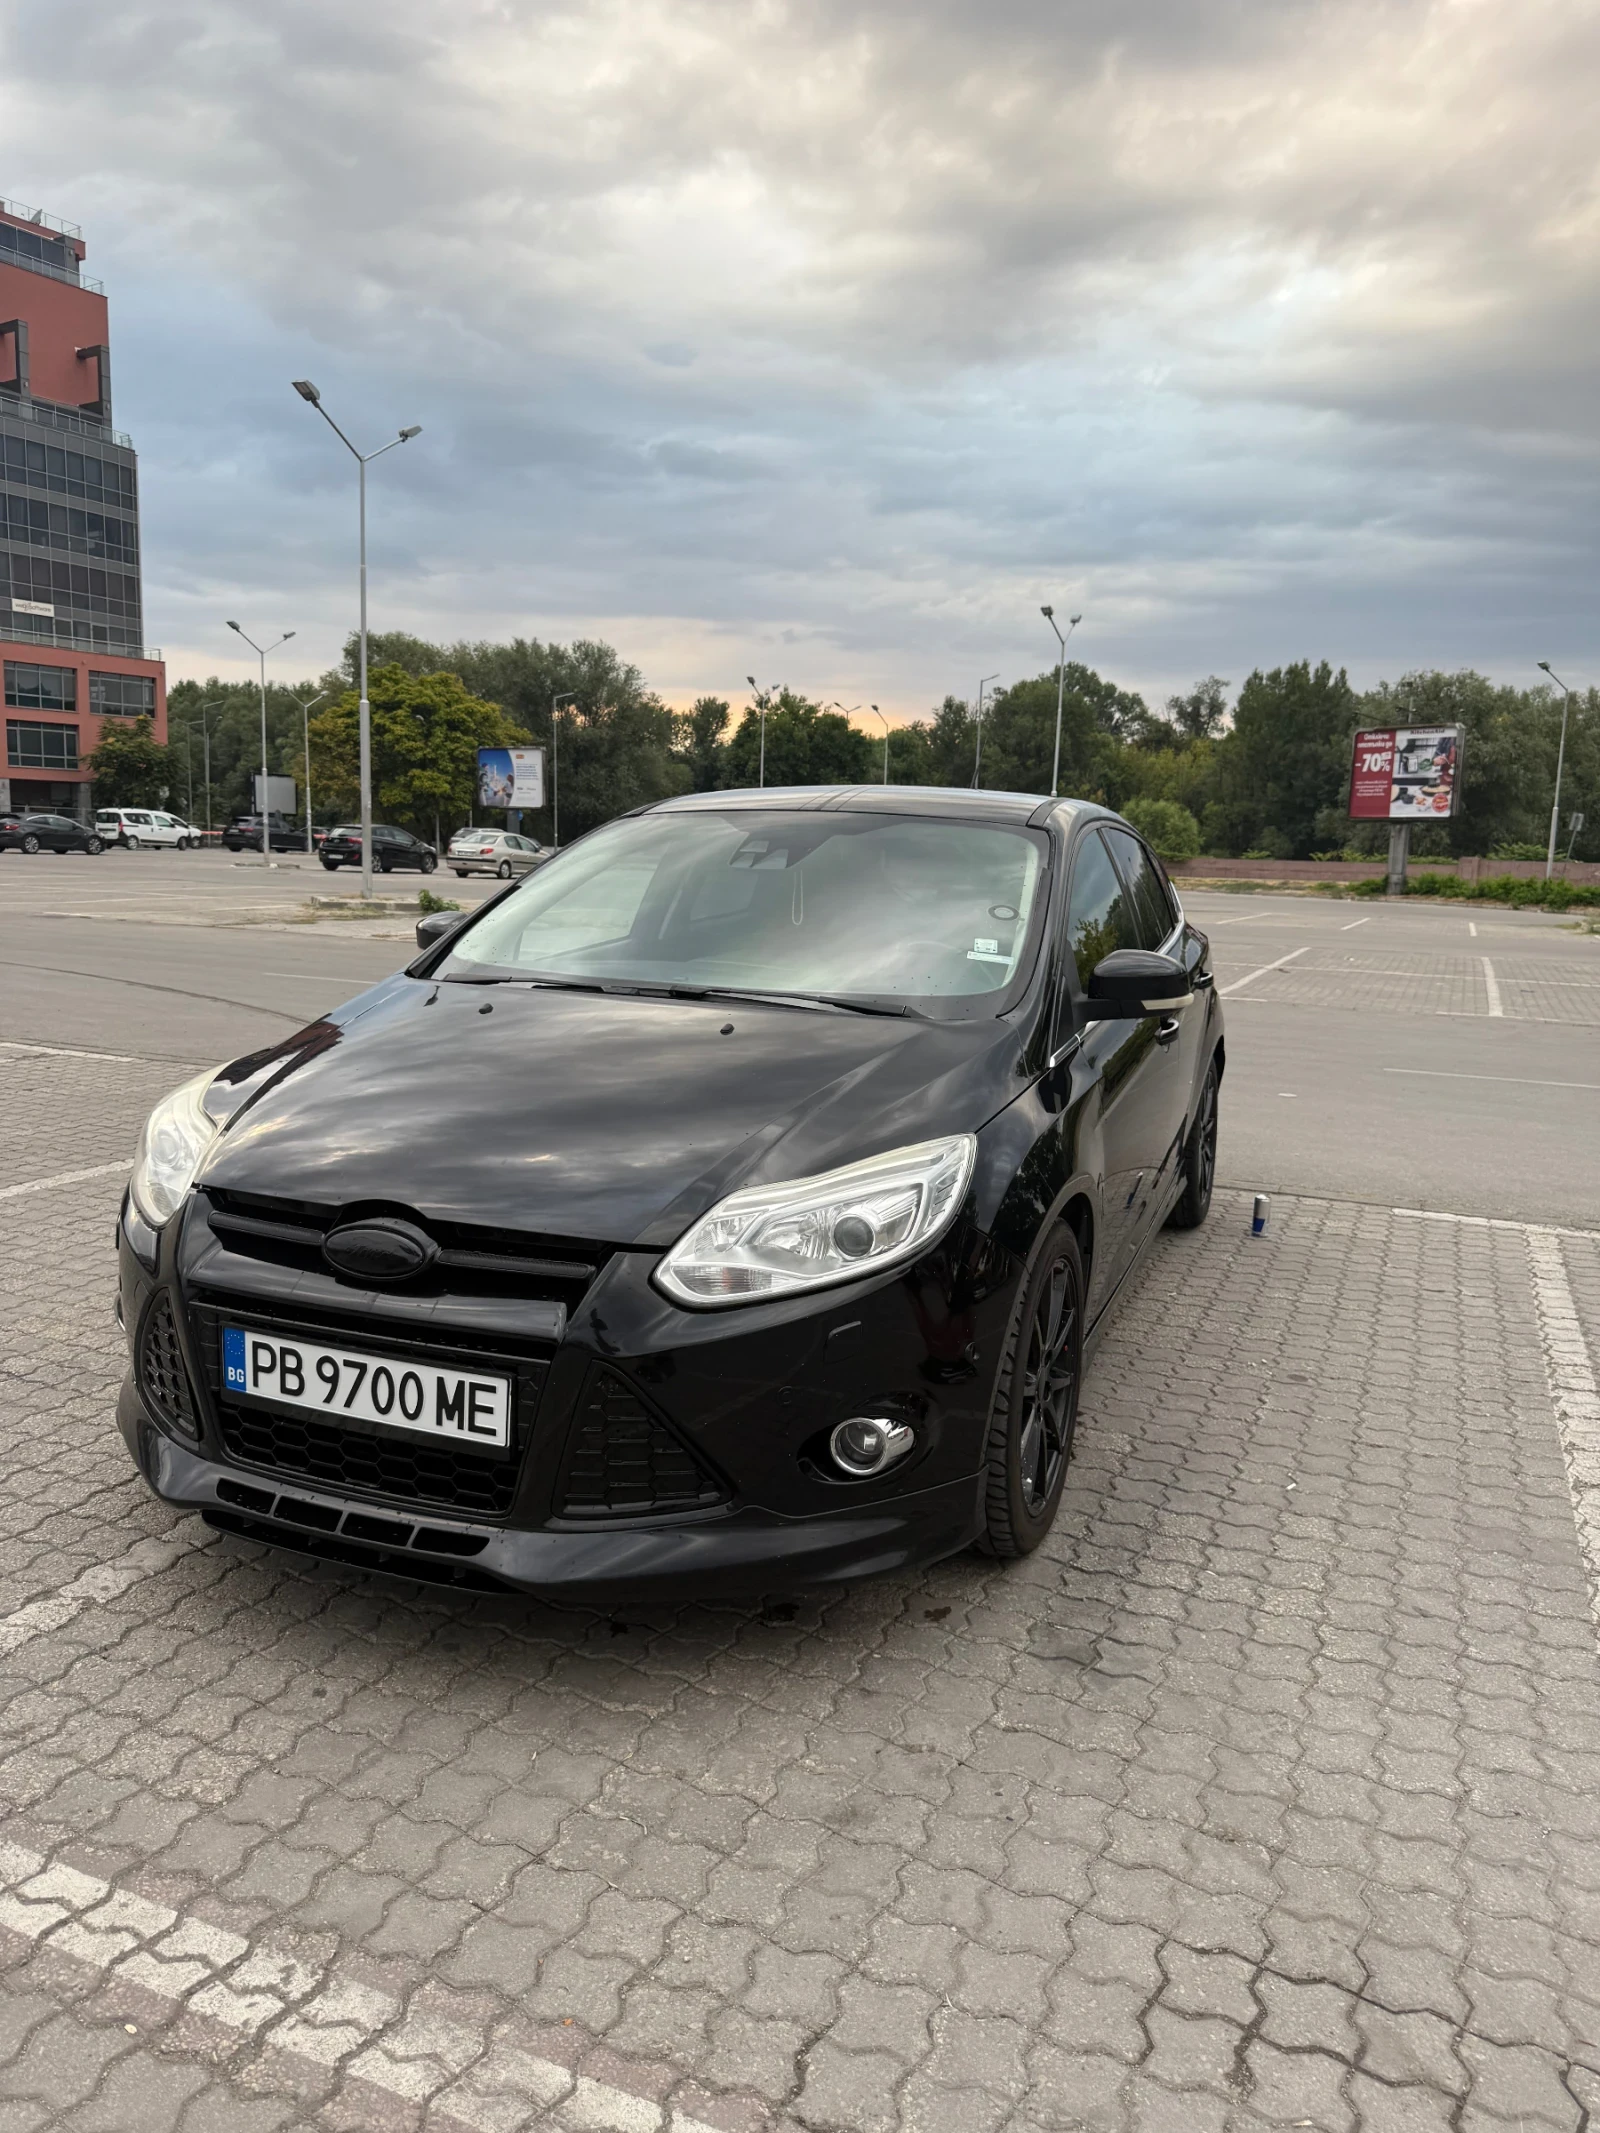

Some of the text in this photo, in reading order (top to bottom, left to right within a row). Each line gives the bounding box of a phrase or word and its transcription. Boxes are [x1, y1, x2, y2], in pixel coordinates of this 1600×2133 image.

[1355, 753, 1391, 772] -70%
[227, 1366, 245, 1384] BG
[251, 1340, 497, 1436] PB 9700 ME
